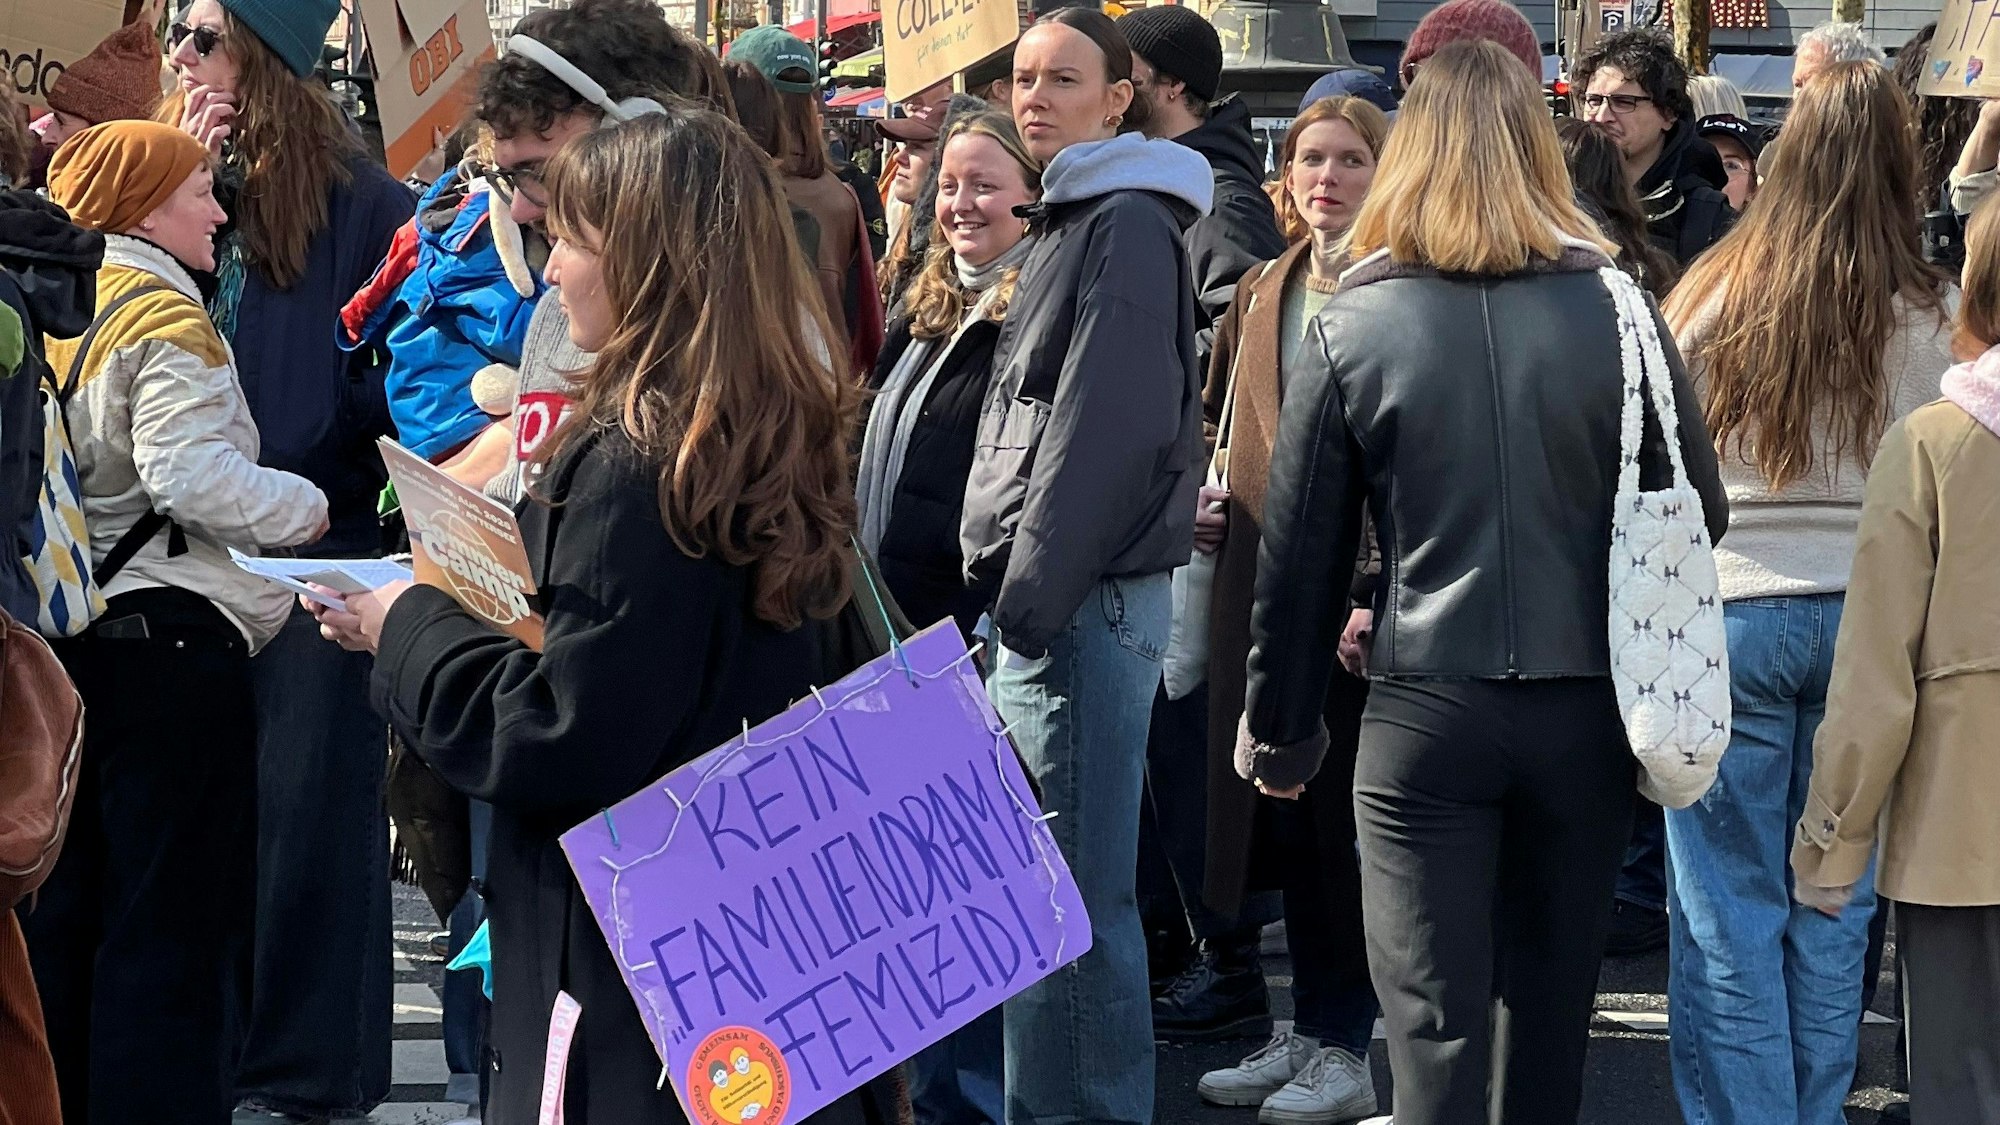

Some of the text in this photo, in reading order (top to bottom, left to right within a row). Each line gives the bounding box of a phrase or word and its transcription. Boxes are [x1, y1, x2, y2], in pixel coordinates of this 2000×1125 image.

[409, 13, 463, 96] OBI
[897, 0, 980, 40] COLL
[1607, 16, 1618, 32] P
[1703, 120, 1748, 132] LOST
[412, 508, 526, 589] Sommer
[421, 529, 531, 621] Camp
[691, 715, 870, 869] KEIN
[764, 885, 1048, 1091] FEMIZID!
[696, 1032, 749, 1070] GEMEINSAM
